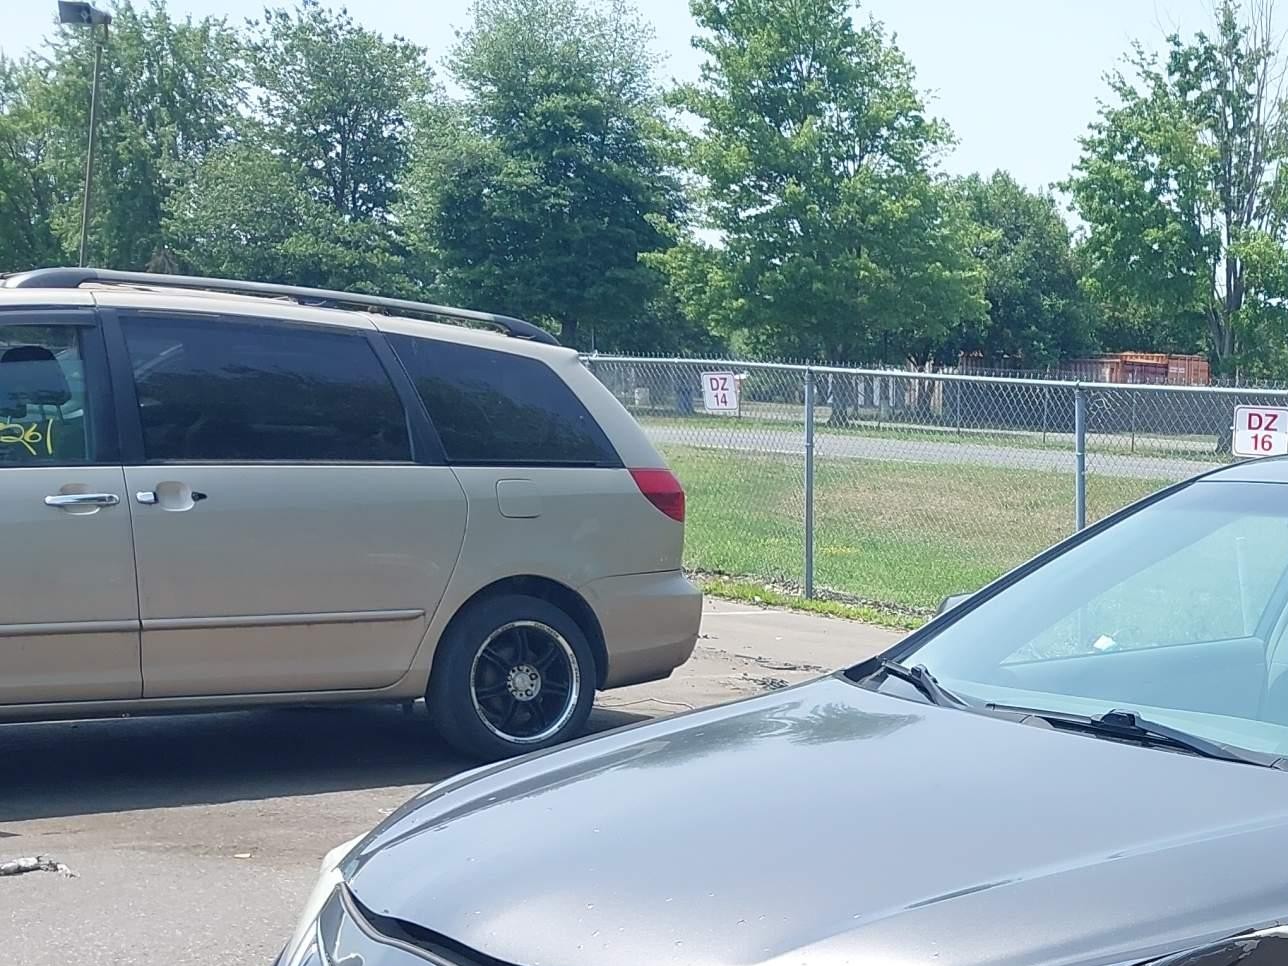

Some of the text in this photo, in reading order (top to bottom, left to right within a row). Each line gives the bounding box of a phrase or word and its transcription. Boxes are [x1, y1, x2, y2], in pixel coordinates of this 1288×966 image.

[710, 377, 729, 391] DZ
[714, 393, 728, 407] 14
[1247, 412, 1279, 432] DZ
[1250, 433, 1273, 452] 16
